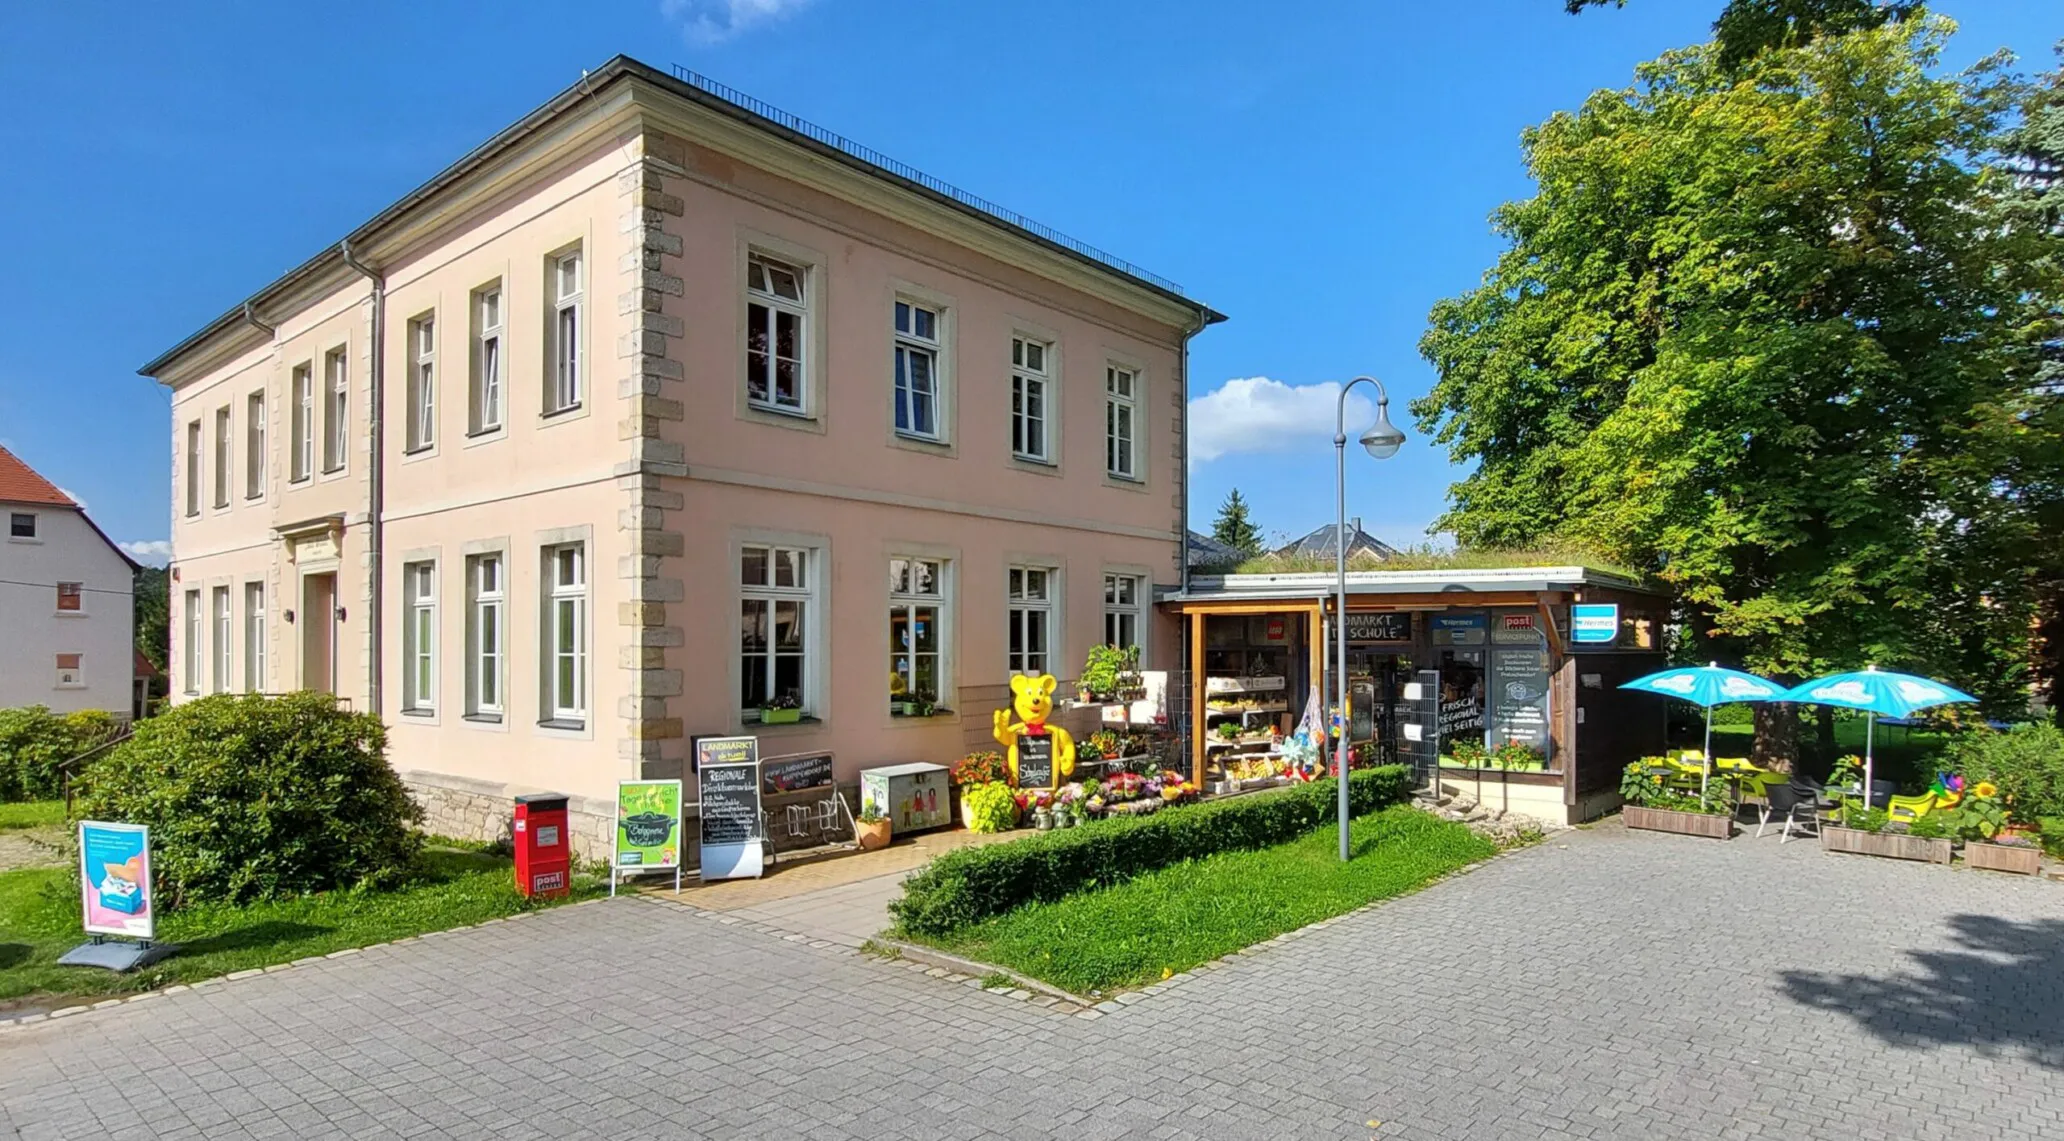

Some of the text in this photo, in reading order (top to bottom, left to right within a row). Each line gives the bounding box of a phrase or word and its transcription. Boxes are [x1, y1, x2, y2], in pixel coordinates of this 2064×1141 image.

[1506, 615, 1530, 626] post
[1442, 696, 1475, 712] FRISCH
[1439, 706, 1480, 724] REGIONAL
[700, 741, 754, 751] LANDMARKT
[708, 769, 748, 782] REGIONALE
[536, 873, 561, 887] post
